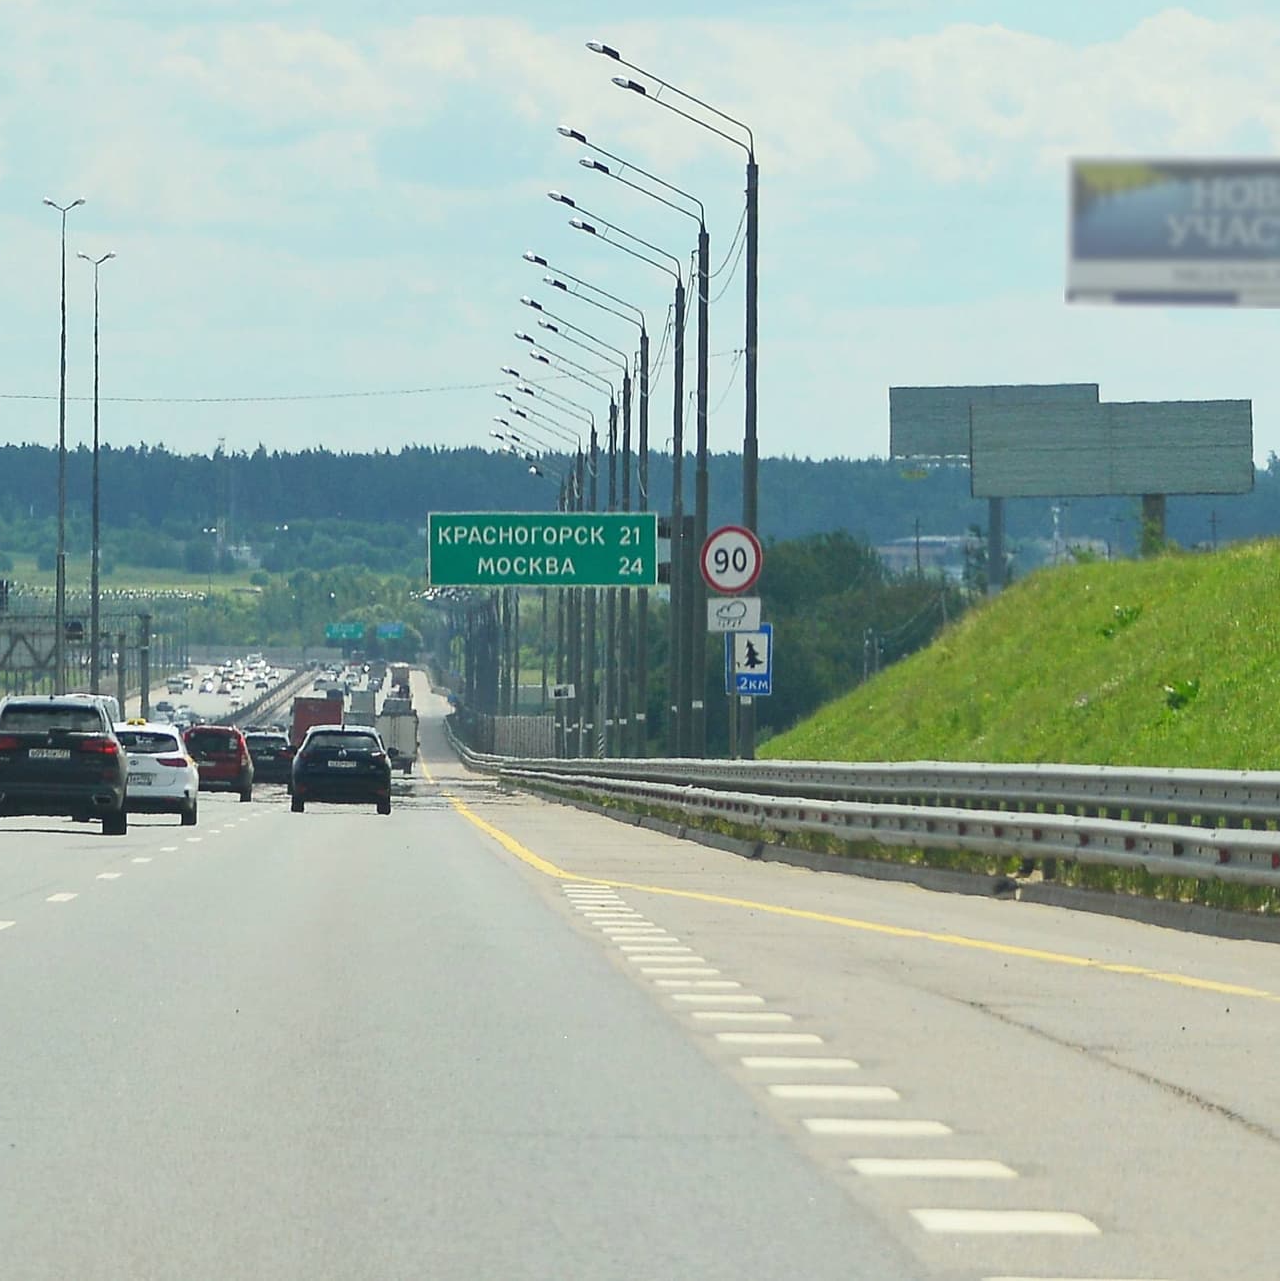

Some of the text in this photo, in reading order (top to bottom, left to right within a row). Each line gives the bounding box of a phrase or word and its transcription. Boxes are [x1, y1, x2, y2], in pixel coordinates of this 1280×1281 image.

[437, 525, 641, 546] КРАСНОГОРСК 21
[477, 556, 644, 576] МОСКВА 24
[713, 546, 748, 574] 90
